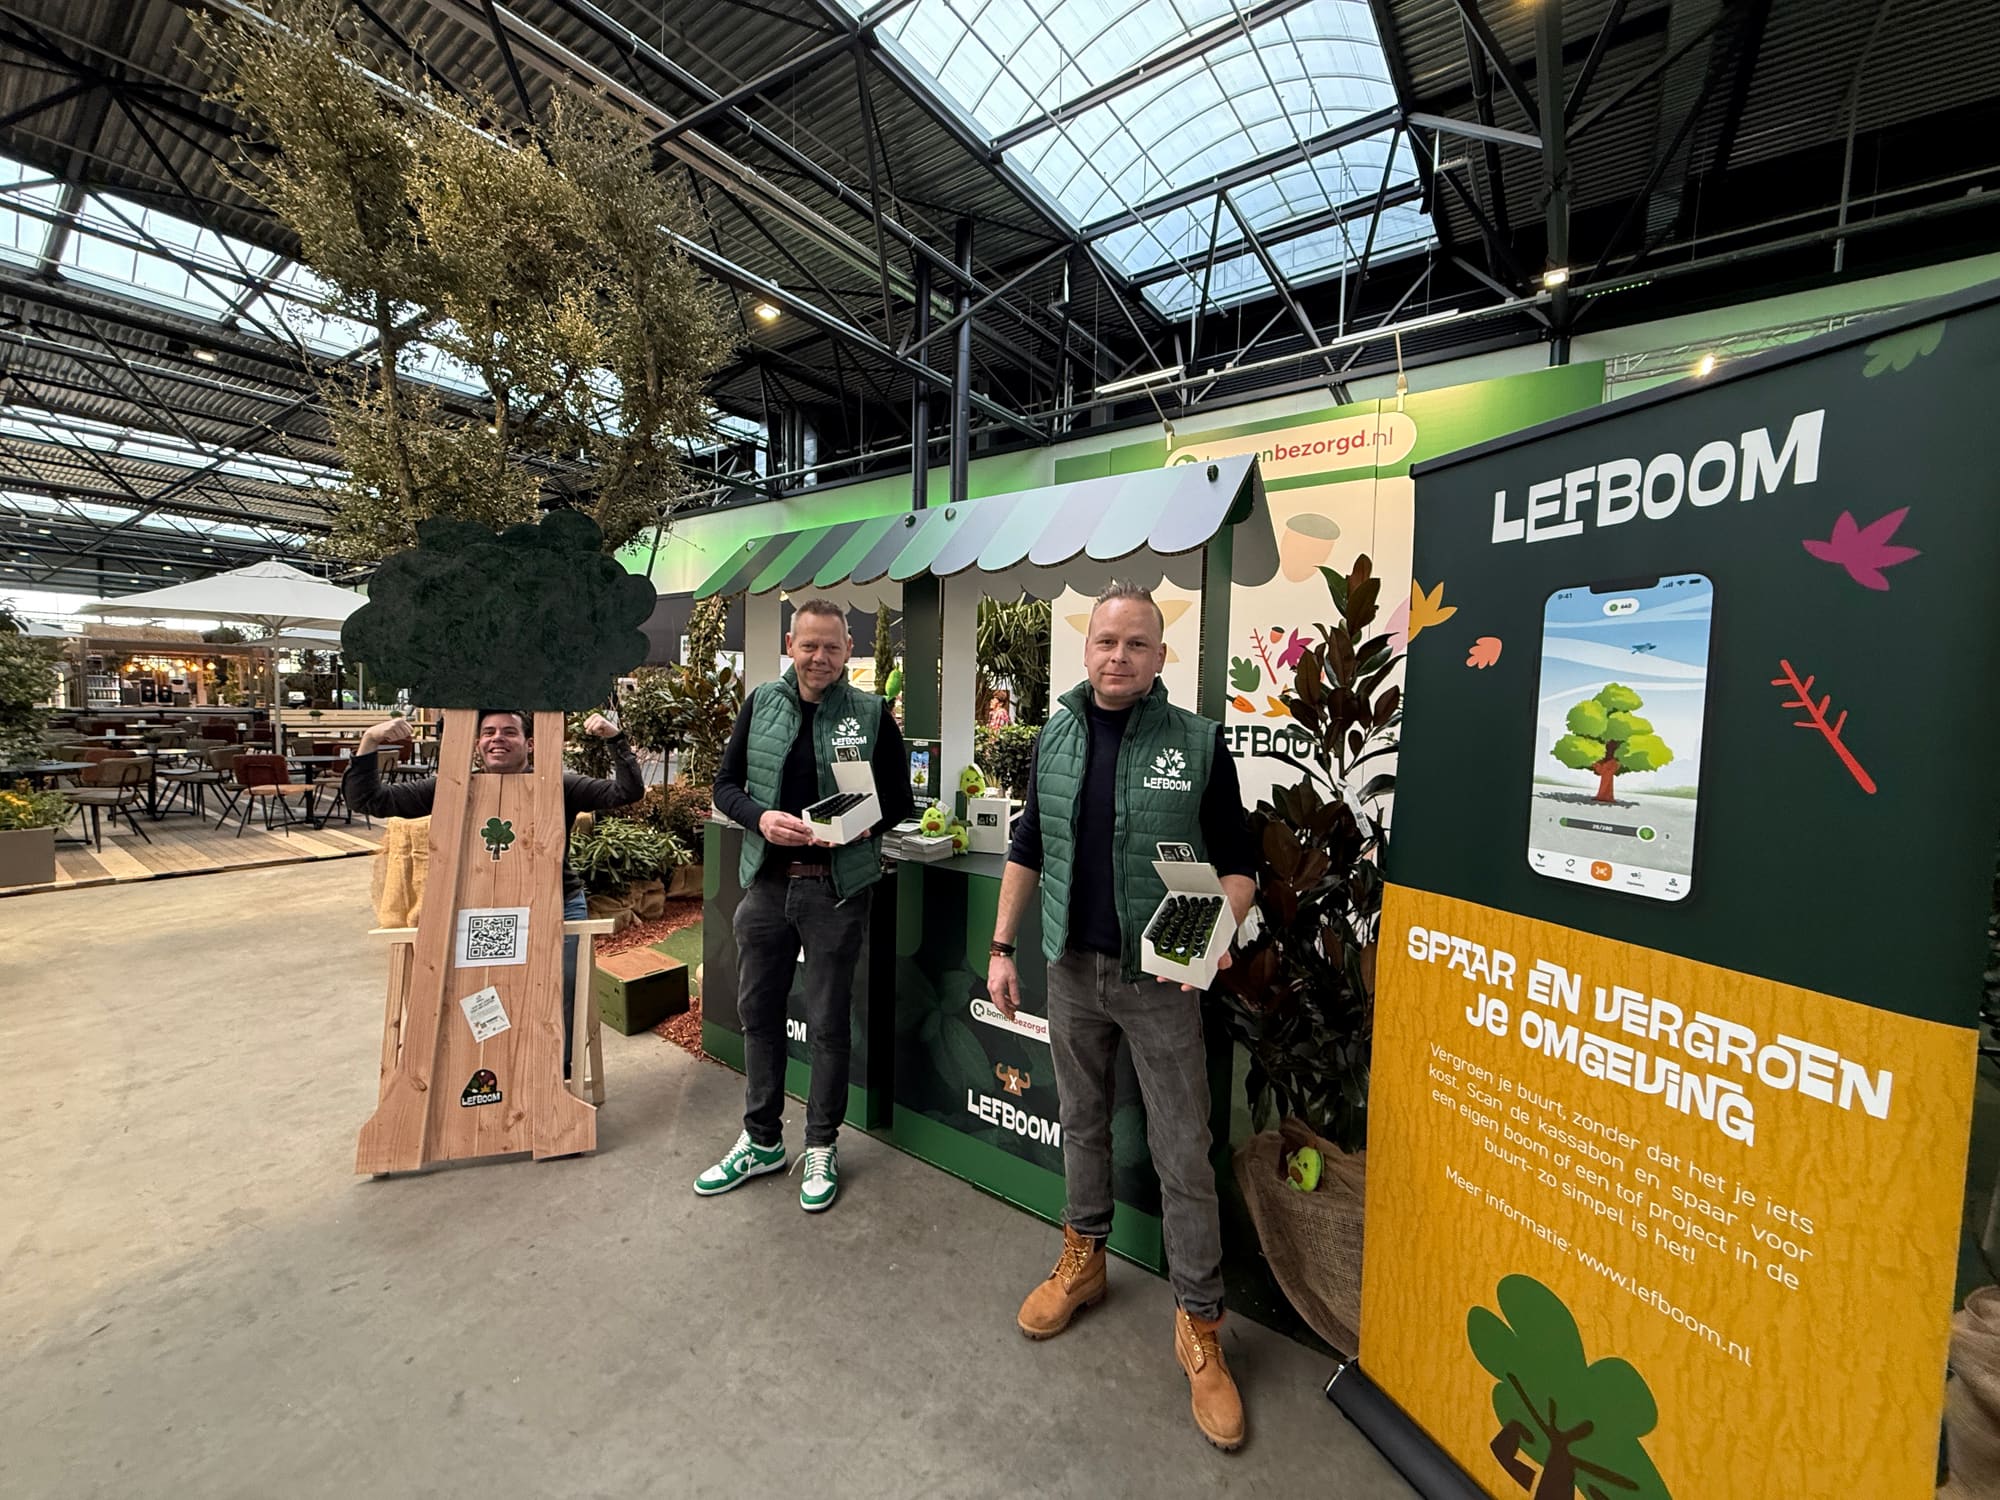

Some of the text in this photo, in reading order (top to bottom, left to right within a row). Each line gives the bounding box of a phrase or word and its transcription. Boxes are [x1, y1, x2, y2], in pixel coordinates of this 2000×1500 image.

[1207, 427, 1393, 462] nbezorgd.nl
[1491, 409, 1825, 544] LEFBOOM
[1143, 776, 1192, 792] LEFBOOM
[1224, 724, 1321, 761] EFBOO
[986, 1007, 1047, 1034] bomebezorgd
[1407, 925, 1893, 1120] SPAAR EN VERGROEN
[967, 1088, 1061, 1148] LEFBOOM
[1429, 1042, 1815, 1235] Vergroen je buurt, zonder dat het je iets
[1429, 1065, 1814, 1263] kost. Scan de kassabon en spaar voor
[1432, 1088, 1800, 1291] een eigen boom of een tof project in de
[1483, 1135, 1696, 1264] buurt- zo simpel is het!
[1445, 1165, 1755, 1367] Meer informatie: www.lefboom.nl
